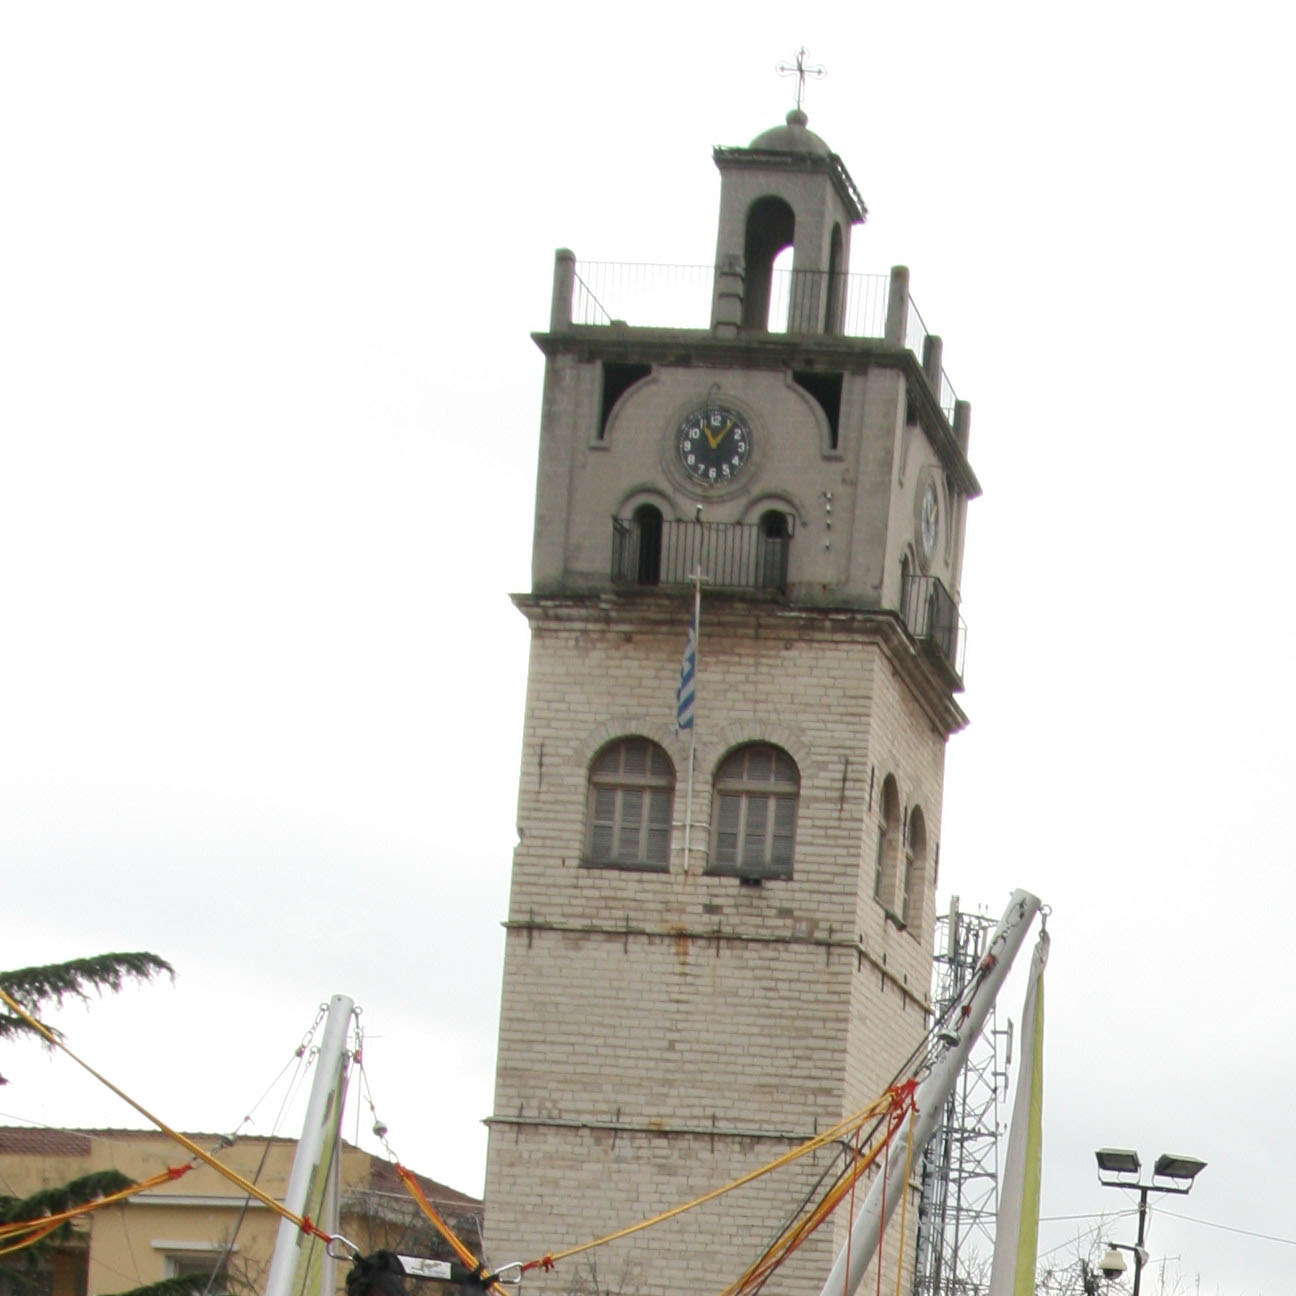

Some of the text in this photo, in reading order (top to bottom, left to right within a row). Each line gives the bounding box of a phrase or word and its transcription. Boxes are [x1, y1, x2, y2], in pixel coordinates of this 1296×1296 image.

[711, 415, 721, 426] 12
[689, 428, 700, 439] 10
[734, 428, 741, 440] 2
[684, 440, 691, 452] 9
[738, 442, 745, 453] 3
[688, 454, 696, 465] 8
[732, 455, 739, 466] 4
[698, 463, 705, 474] 7
[709, 467, 717, 479] 6
[722, 463, 730, 476] 5
